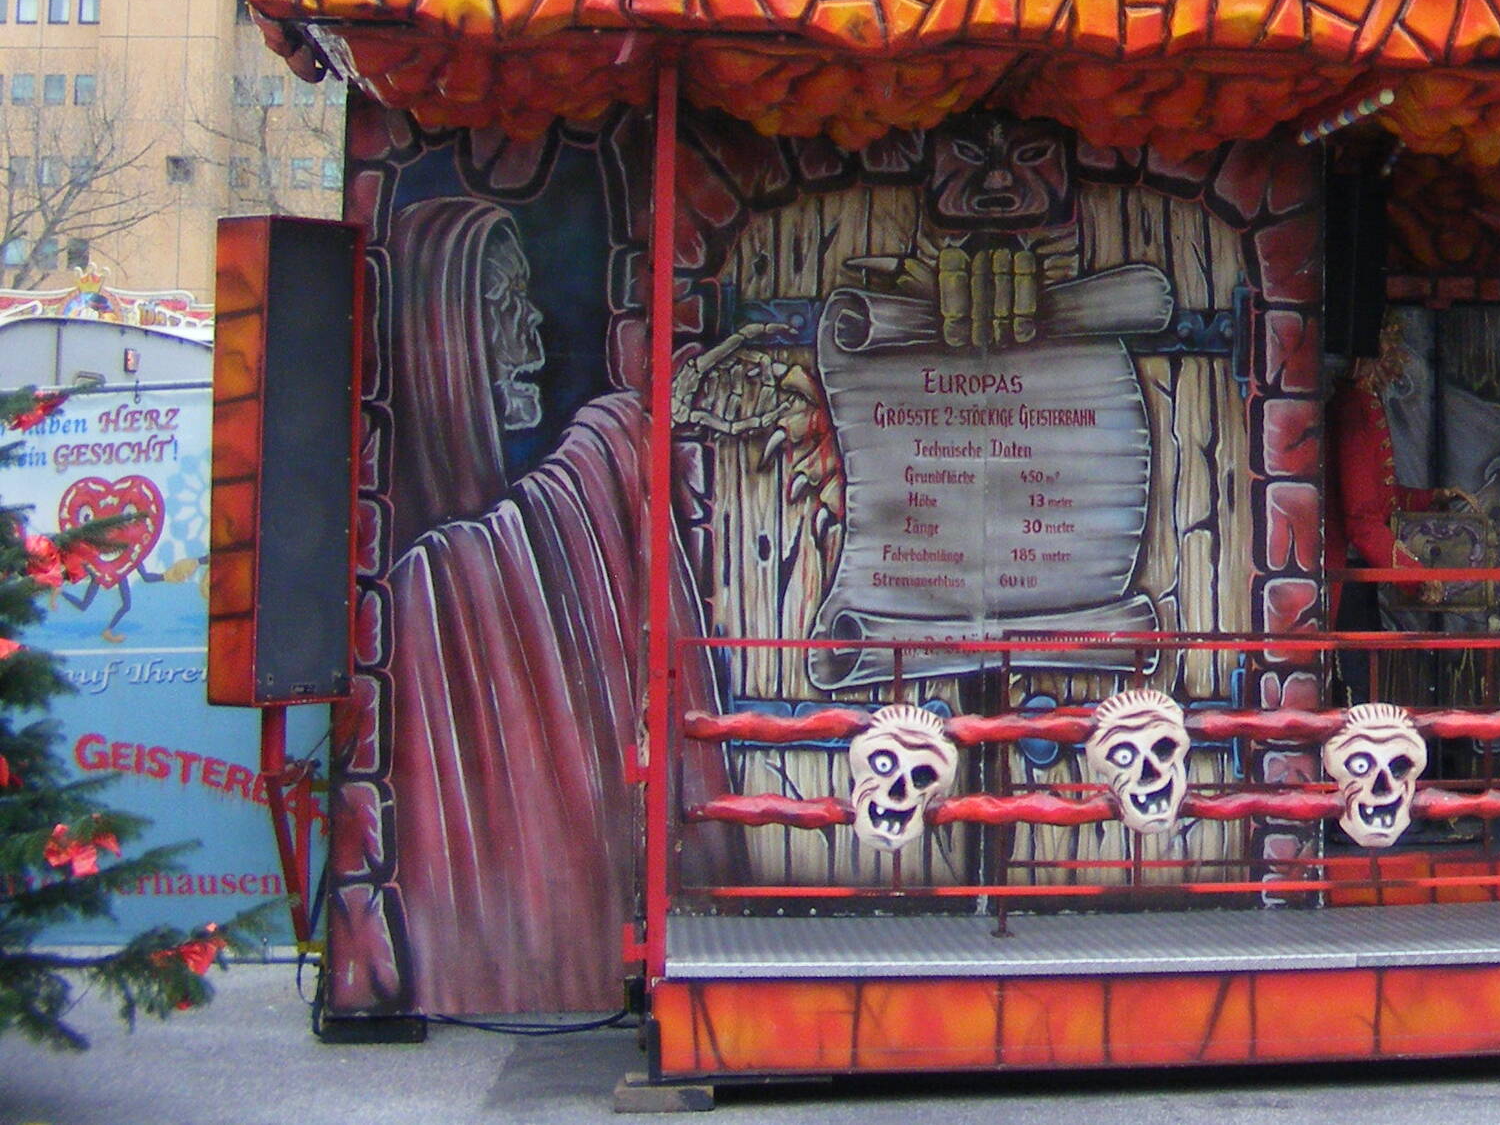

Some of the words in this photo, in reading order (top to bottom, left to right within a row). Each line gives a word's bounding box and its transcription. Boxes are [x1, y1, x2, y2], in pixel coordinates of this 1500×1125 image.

[921, 368, 1024, 395] EUROPAS
[98, 404, 180, 433] HERZ
[873, 401, 939, 428] GRÖSSTE
[1019, 403, 1096, 429] GEISTERBAHN
[914, 439, 982, 458] Technische
[990, 438, 1032, 458] Daten
[1020, 469, 1043, 483] 450
[908, 491, 937, 507] Höhe
[1028, 493, 1045, 508] 13
[904, 516, 939, 537] Länge
[1022, 519, 1042, 534] 30
[1010, 547, 1036, 562] 185
